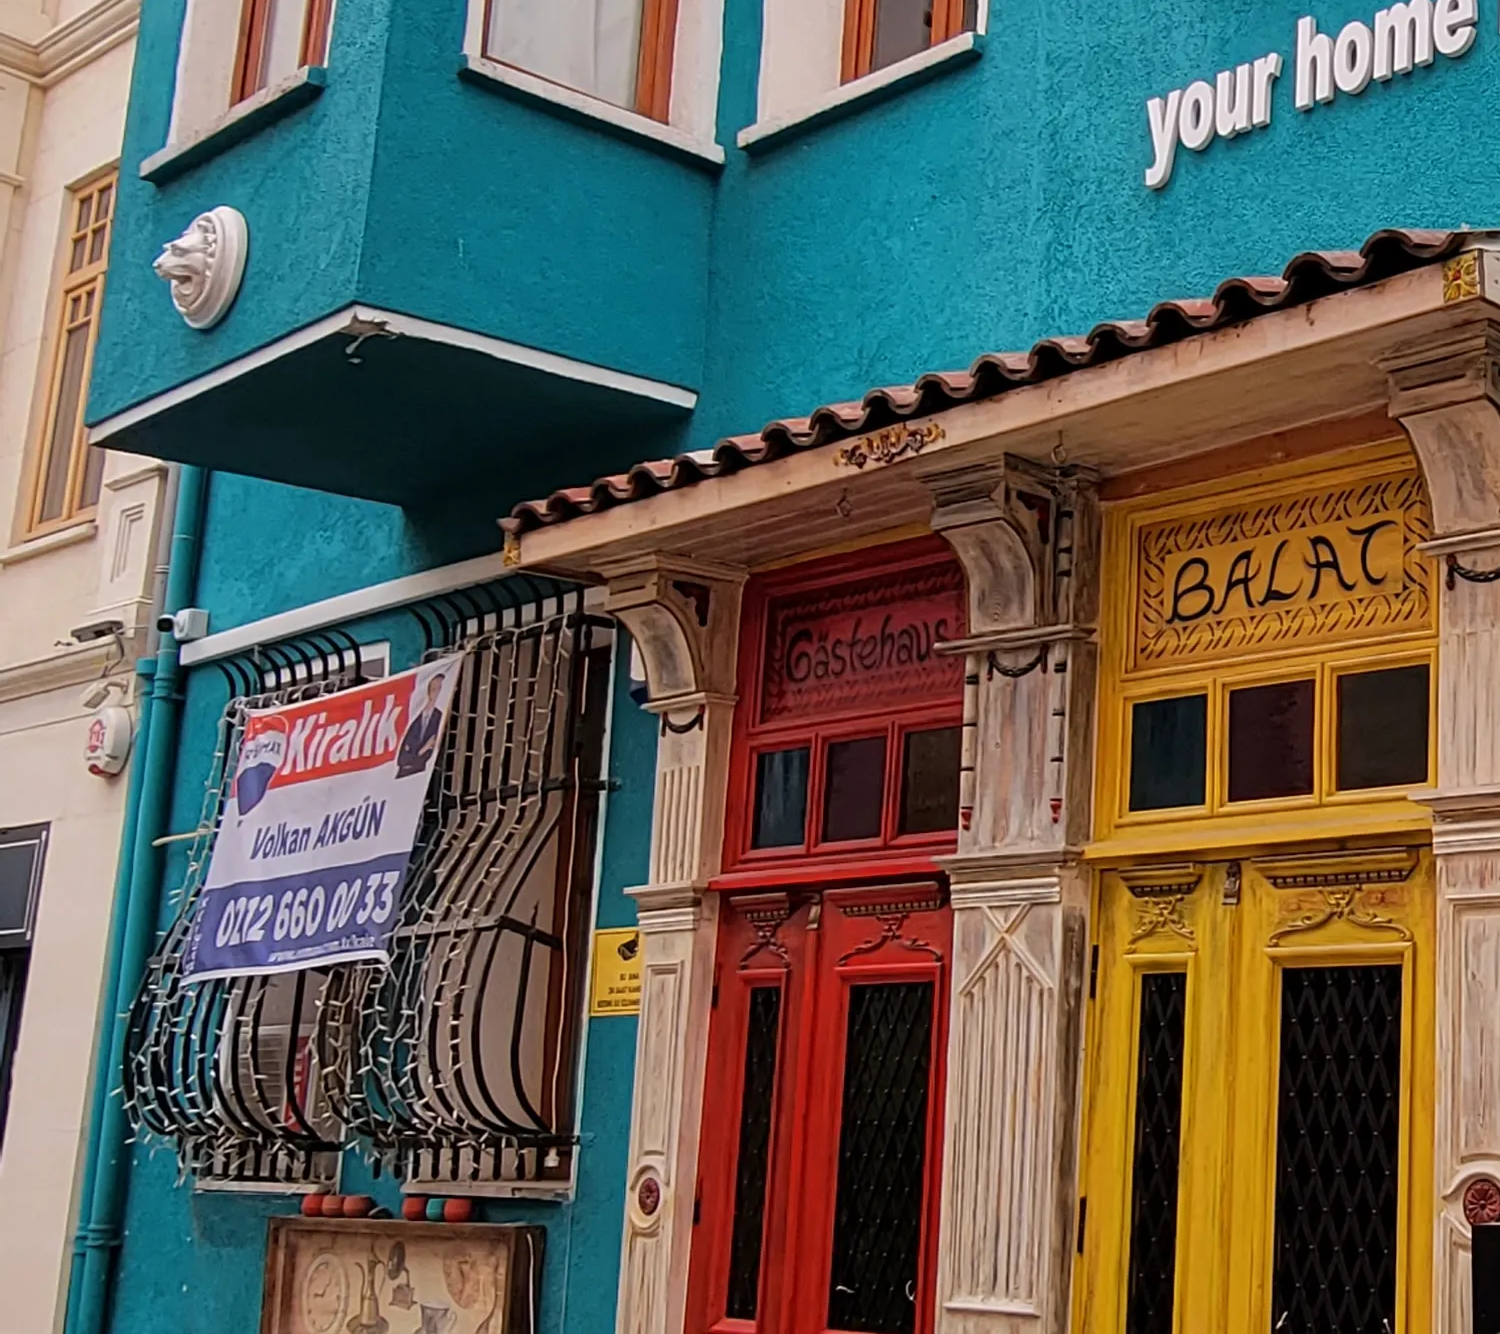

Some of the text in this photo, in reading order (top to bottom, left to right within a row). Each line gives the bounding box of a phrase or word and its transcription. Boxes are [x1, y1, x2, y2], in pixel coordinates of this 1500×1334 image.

[1144, 50, 1282, 190] your
[1166, 519, 1398, 624] BALAT
[786, 614, 951, 683] Gästehaus
[281, 694, 403, 776] Kiralık
[250, 795, 387, 860] Volkan AKGÜN
[273, 885, 326, 941] 660
[326, 878, 362, 933] 00
[356, 870, 401, 924] 33
